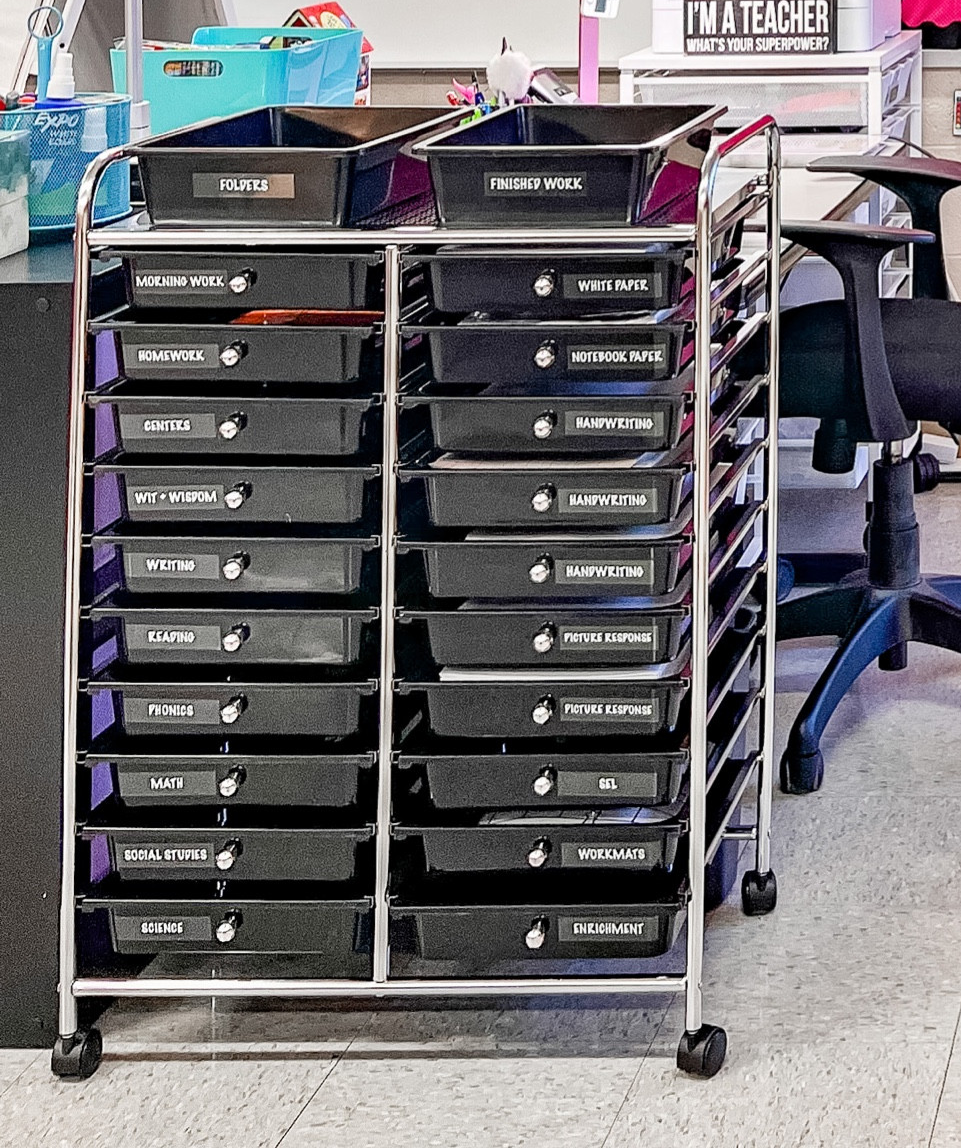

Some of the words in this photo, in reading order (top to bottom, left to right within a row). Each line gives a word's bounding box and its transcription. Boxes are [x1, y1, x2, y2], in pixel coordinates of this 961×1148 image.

[686, 0, 717, 35] I'M
[721, 0, 737, 35] A
[739, 0, 830, 34] TEACHER
[686, 37, 726, 53] WHAT'S
[726, 37, 754, 53] YOUR
[755, 36, 830, 52] SUPERPOWER?
[34, 111, 80, 132] EXPO
[220, 178, 269, 192] FOLDERS
[490, 177, 541, 190] FINISHED
[543, 177, 583, 190] WORK
[135, 275, 188, 287] MORNING
[189, 275, 225, 288] WORK
[577, 279, 613, 292] WHITE
[614, 279, 649, 292] PAPER
[138, 349, 205, 362] HOMEWORK
[571, 350, 628, 363] NOTEBOOK
[629, 350, 664, 362] PAPER
[144, 419, 191, 432] CENTERS
[576, 416, 654, 430] HANDWRITING
[134, 491, 158, 504] WIT
[168, 490, 217, 504] WISDOM
[569, 494, 648, 507] HANDWRITING
[146, 558, 196, 572] WRITING
[566, 565, 644, 578] HANDWRITING
[148, 630, 195, 643] READING
[563, 632, 603, 643] PICTURE
[604, 632, 652, 643] RESPONSE
[148, 703, 194, 717] PHONICS
[564, 703, 604, 715] PICTURE
[605, 704, 653, 716] RESPONSE
[150, 777, 184, 790] MATH
[598, 777, 618, 790] SEL
[124, 848, 163, 861] SOCIAL
[164, 848, 208, 861] STUDIES
[577, 848, 646, 861] WORKMATS
[141, 921, 183, 934] SCIENCE
[573, 922, 645, 935] ENRICHMENT
